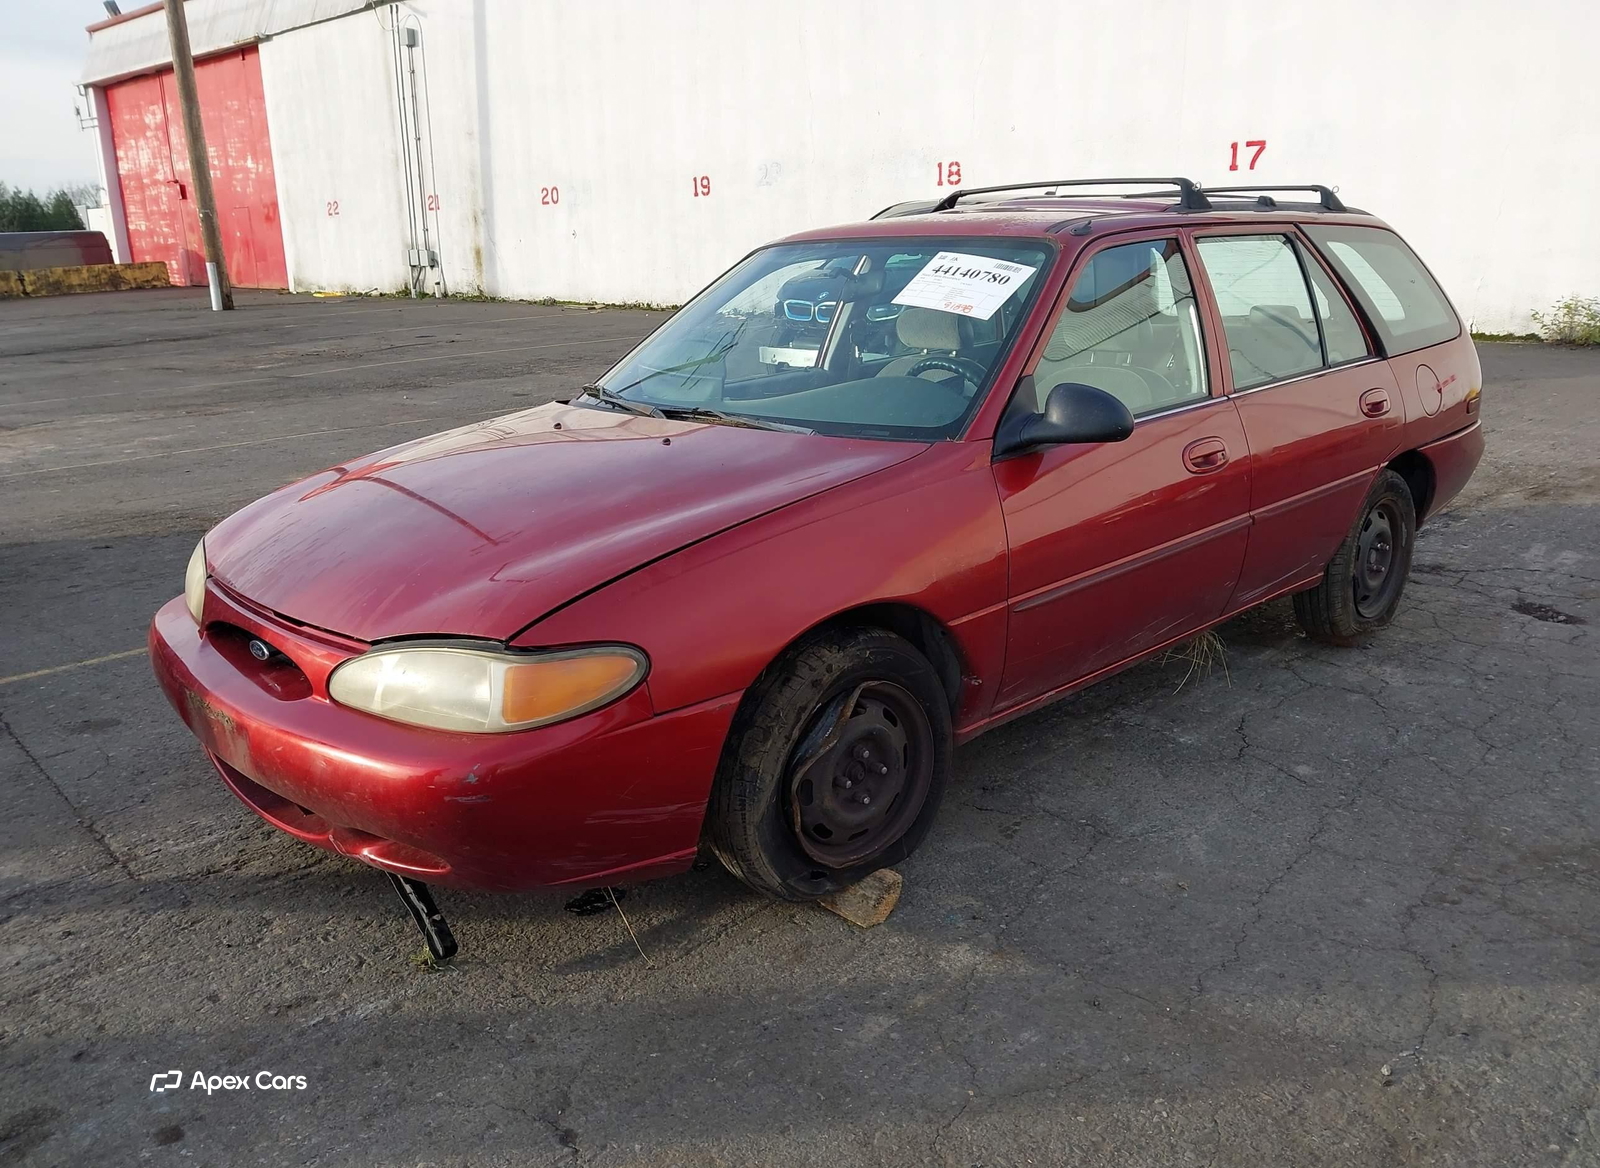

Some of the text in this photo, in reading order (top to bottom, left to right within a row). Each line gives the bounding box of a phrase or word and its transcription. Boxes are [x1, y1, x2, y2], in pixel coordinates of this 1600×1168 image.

[1229, 140, 1267, 171] 17
[937, 161, 961, 186] 18
[541, 186, 560, 205] 20
[692, 175, 711, 197] 19
[327, 200, 340, 216] 22
[427, 194, 440, 211] 21
[932, 264, 1011, 286] 44140780
